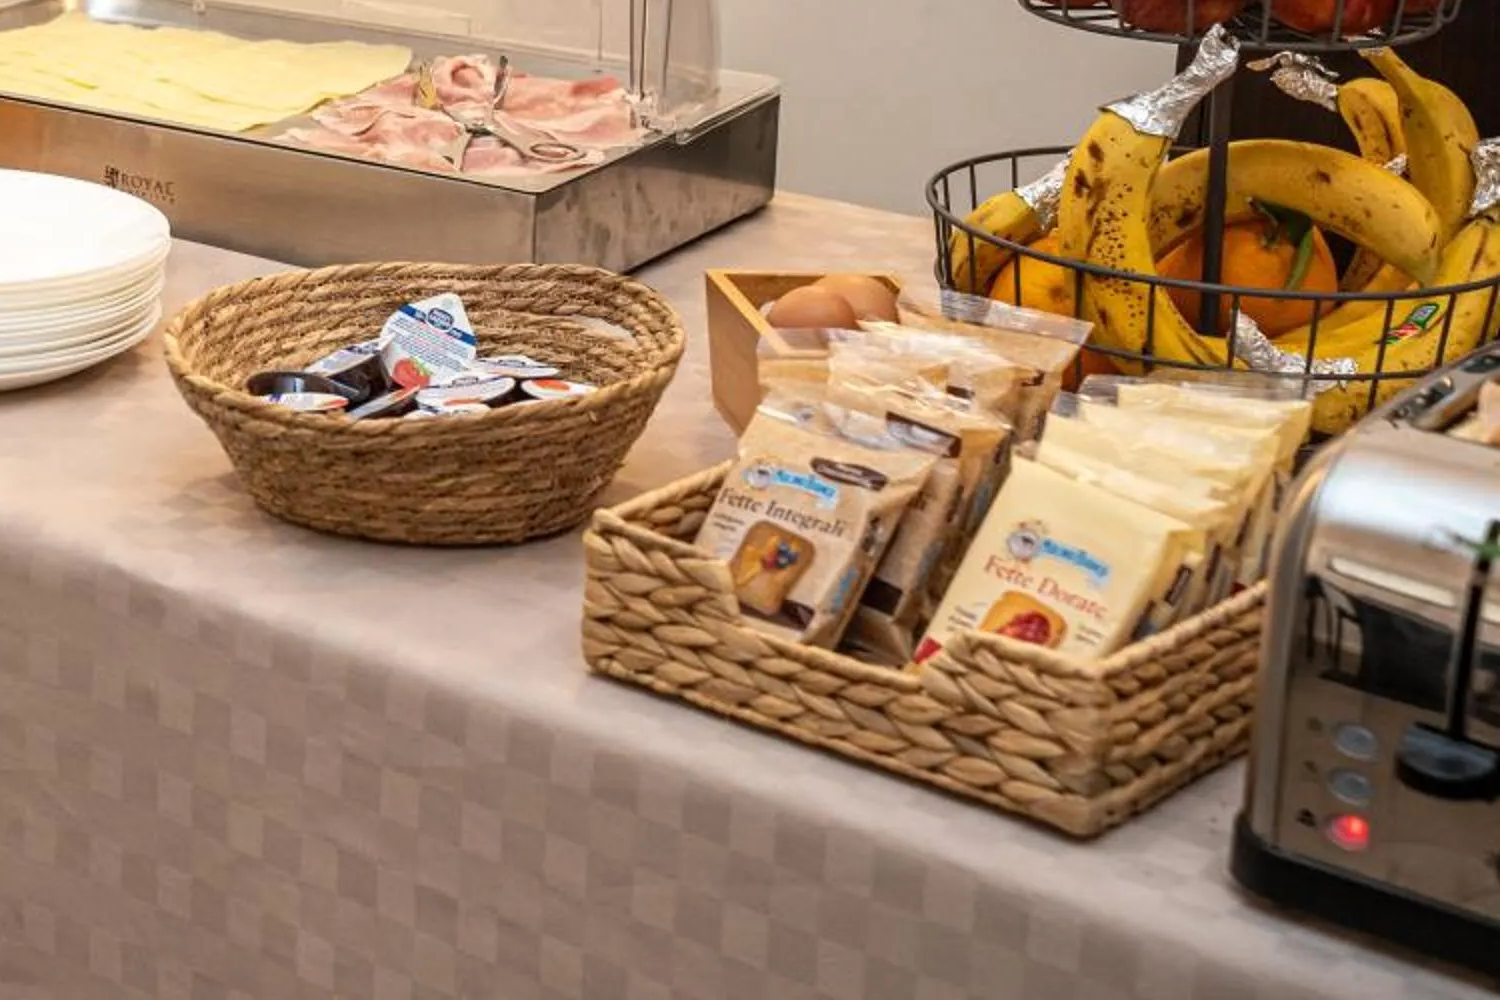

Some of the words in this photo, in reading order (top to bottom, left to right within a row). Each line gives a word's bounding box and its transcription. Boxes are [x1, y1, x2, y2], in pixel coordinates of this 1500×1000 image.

[718, 487, 764, 514] Fette
[765, 500, 846, 537] Integrali
[984, 554, 1034, 588] Fette
[1037, 577, 1109, 620] Dorate
